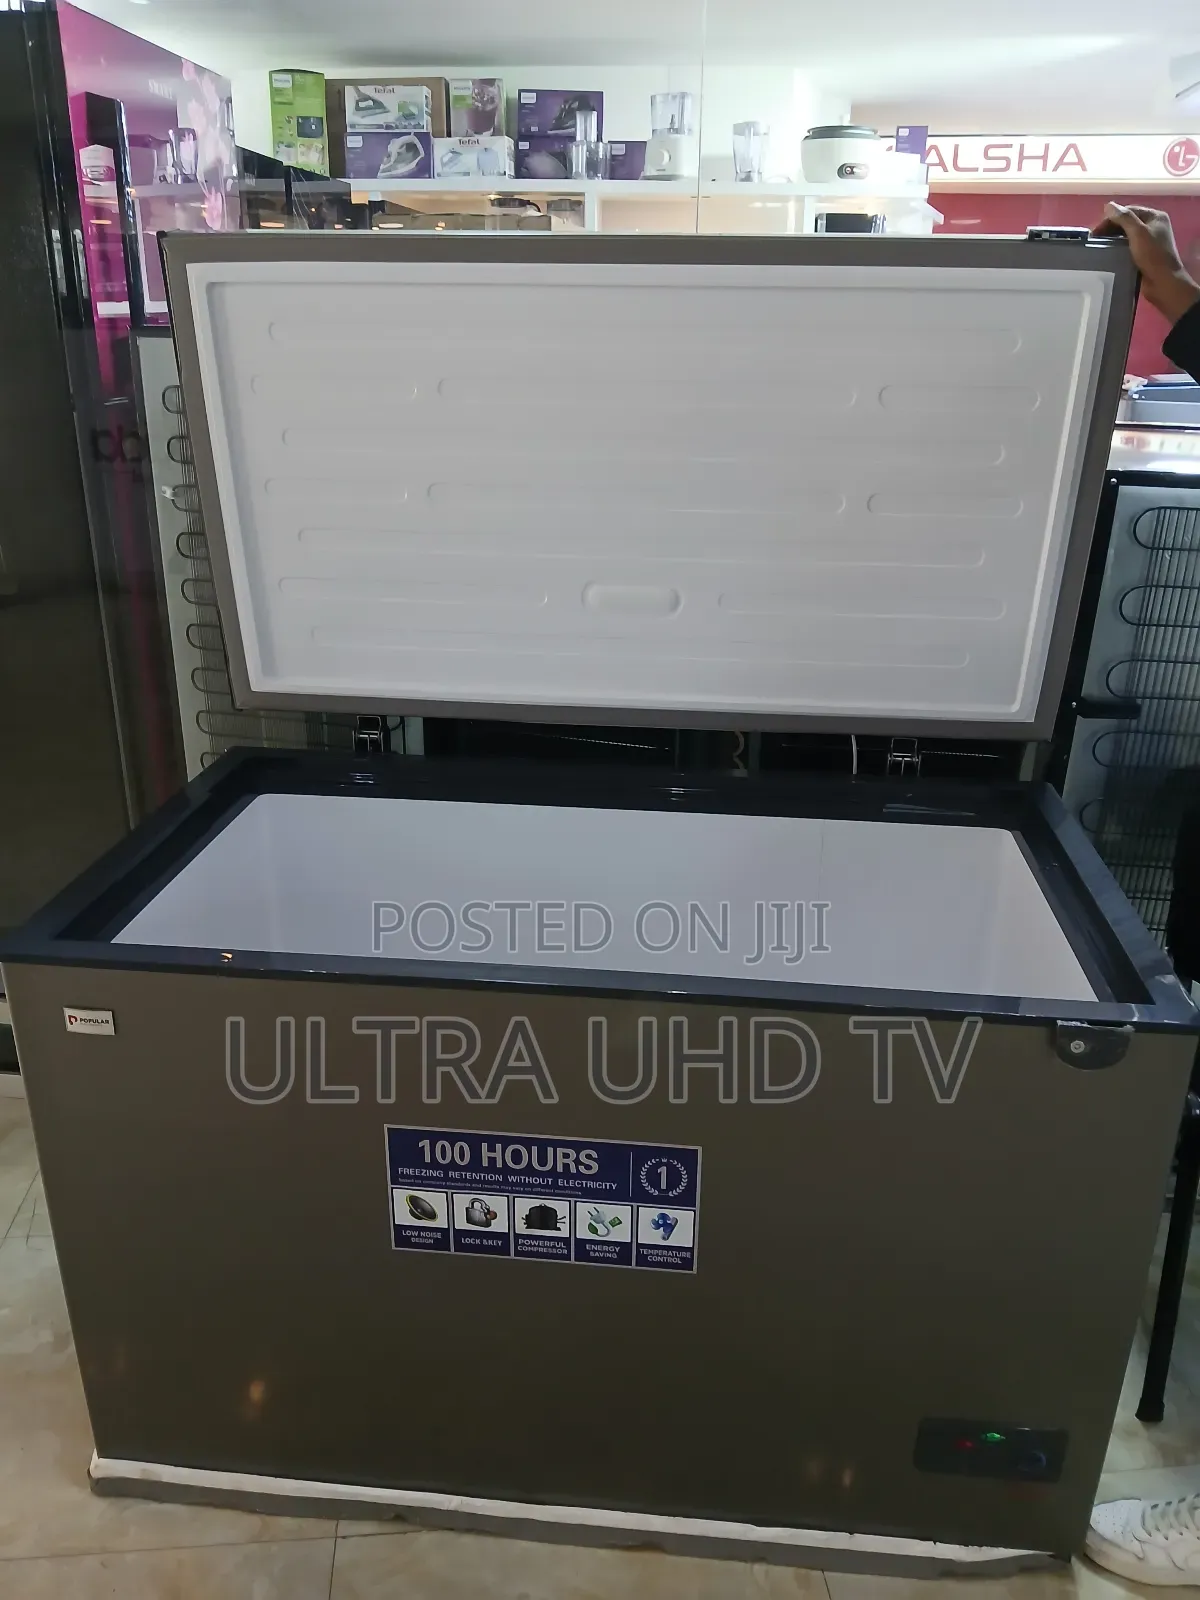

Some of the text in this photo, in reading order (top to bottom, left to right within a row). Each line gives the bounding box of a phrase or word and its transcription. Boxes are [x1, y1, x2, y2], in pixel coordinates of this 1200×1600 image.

[458, 138, 480, 146] Tefal
[886, 142, 1088, 173] ALSHA
[418, 1139, 599, 1175] 100 HOURS
[398, 1167, 617, 1190] FREEZING RETENTION WITHOUT ELECTRICITY
[657, 1165, 668, 1190] 1
[518, 1239, 567, 1249] POWERFUL
[586, 1244, 621, 1253] ENERGY
[517, 1245, 568, 1255] COMPRESSOR
[589, 1251, 618, 1259] SAVING
[639, 1248, 692, 1259] TEMPERATURE
[647, 1255, 682, 1264] CONTROL
